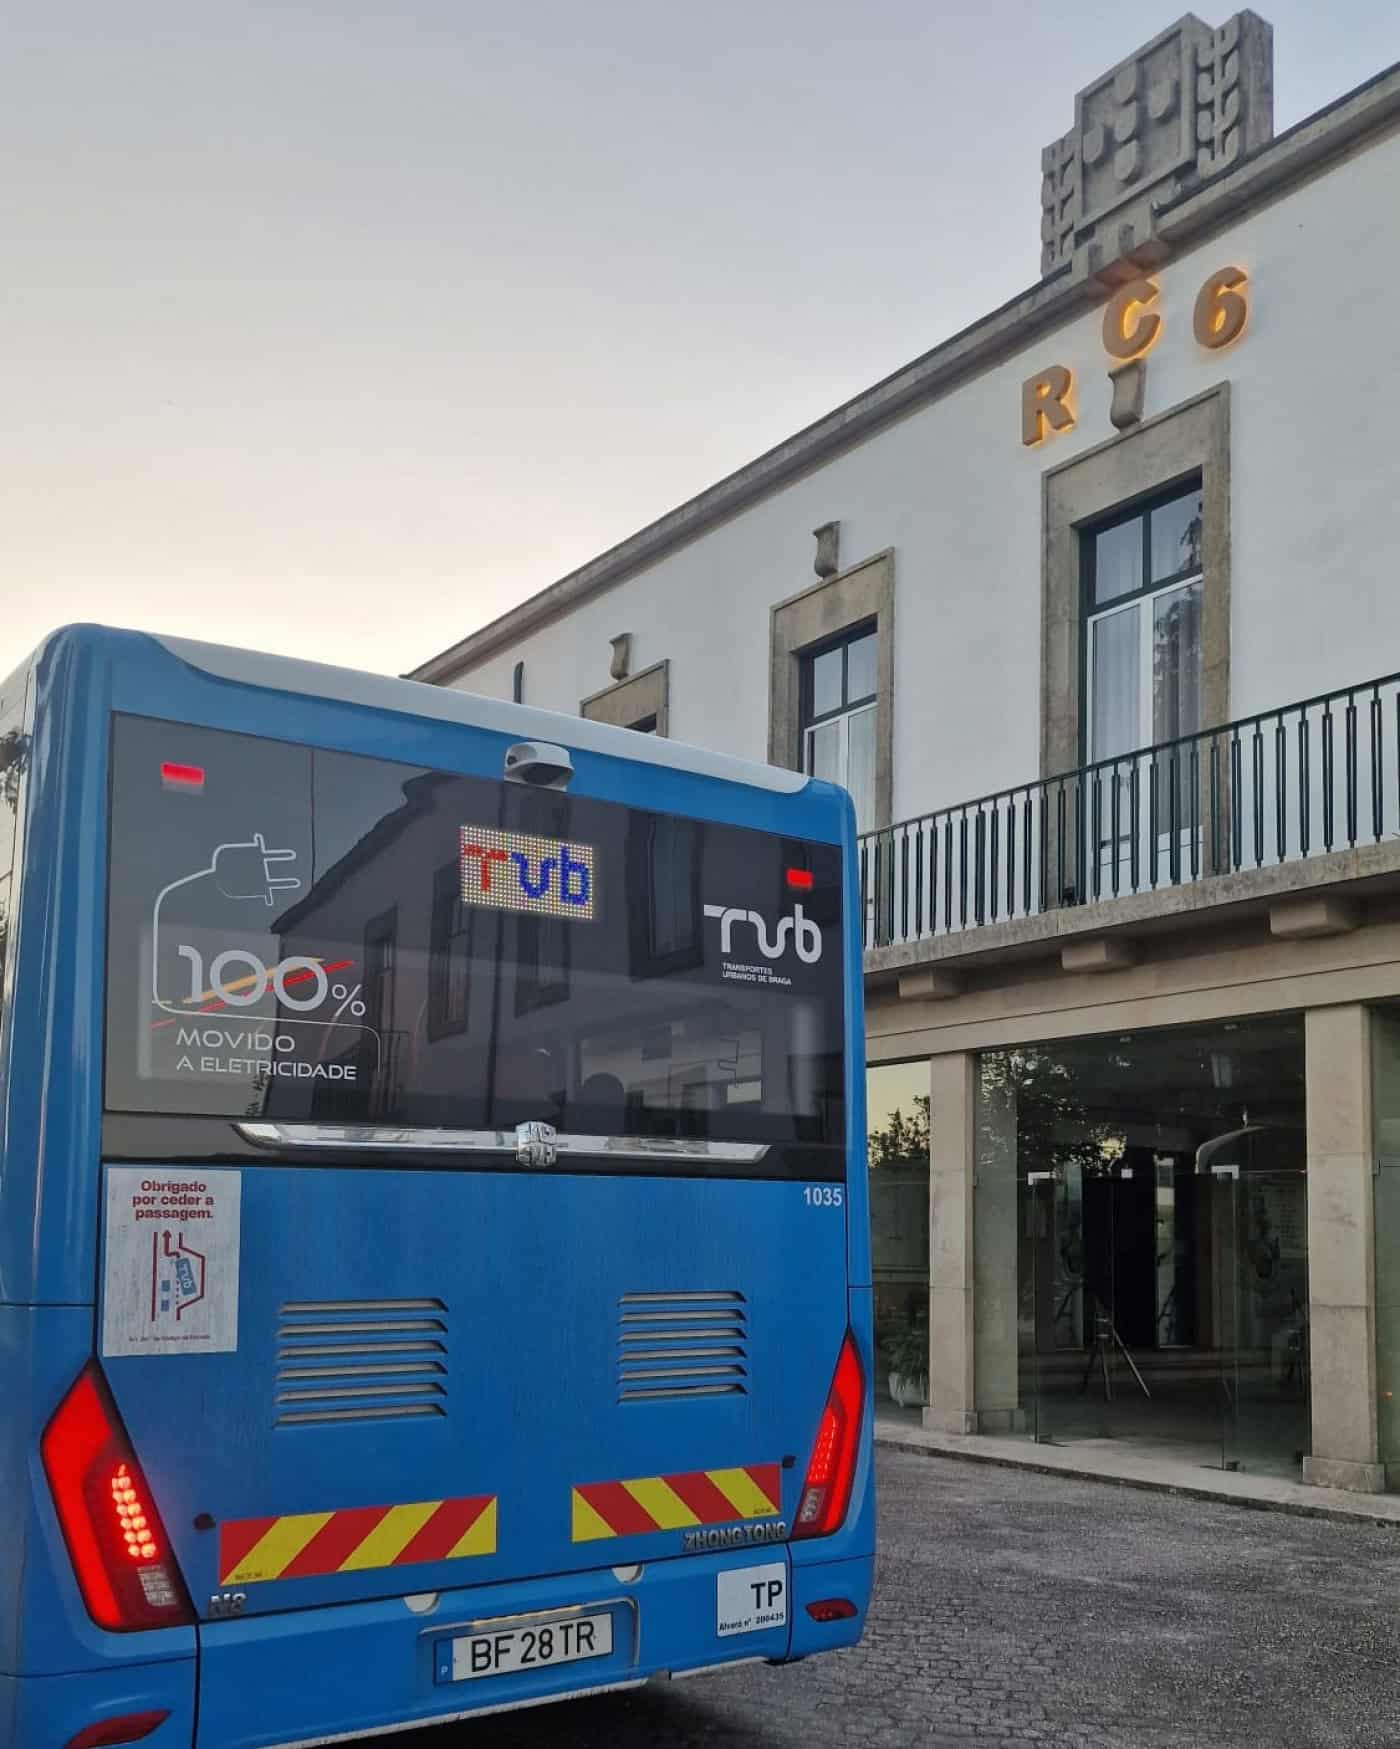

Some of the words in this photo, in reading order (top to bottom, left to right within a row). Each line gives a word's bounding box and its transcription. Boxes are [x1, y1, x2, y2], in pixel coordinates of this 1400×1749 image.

[178, 944, 367, 1017] 100%
[176, 1027, 296, 1052] MOVIDO
[176, 1055, 194, 1071] A
[200, 1056, 357, 1080] ELETRICIDADE
[141, 1180, 207, 1194] Obrigado
[803, 1186, 843, 1207] 1035
[132, 1195, 156, 1207] por
[160, 1194, 202, 1206] ceder
[205, 1196, 215, 1206] a
[135, 1208, 214, 1221] passagem.
[750, 1579, 783, 1609] TP
[471, 1634, 514, 1673] BF
[520, 1627, 554, 1664] 28
[559, 1620, 595, 1656] TR
